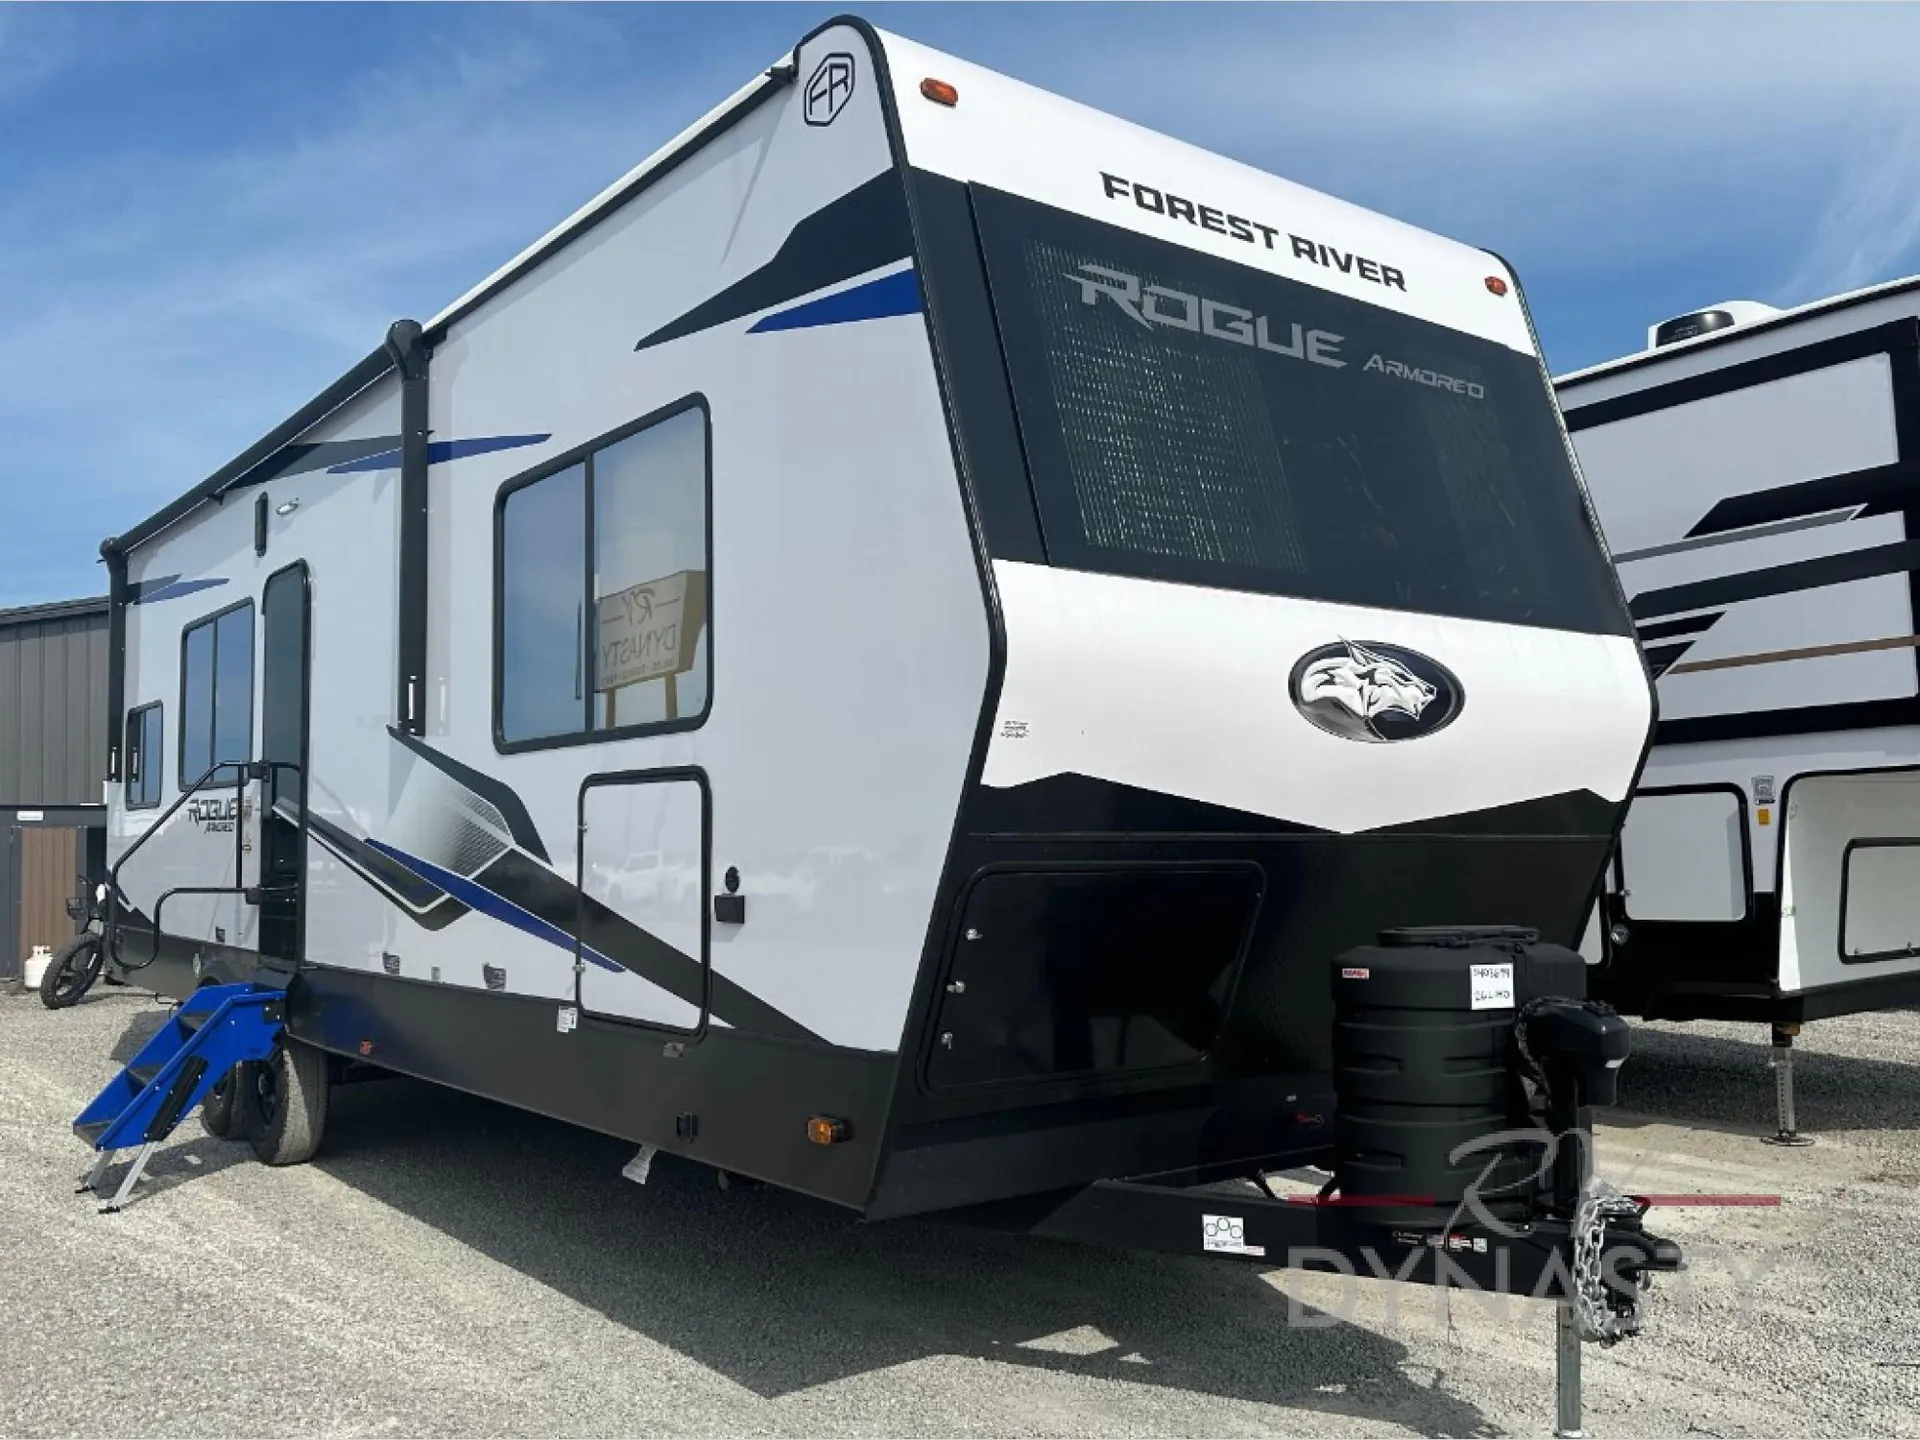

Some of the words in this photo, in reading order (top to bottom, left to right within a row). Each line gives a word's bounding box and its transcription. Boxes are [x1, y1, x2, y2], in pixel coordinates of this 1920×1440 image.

[1099, 171, 1279, 250] FOREST
[1288, 233, 1408, 293] RIVER
[1063, 263, 1348, 369] ROGUE
[1362, 354, 1485, 400] ARMORED
[187, 796, 238, 827] ROGUE
